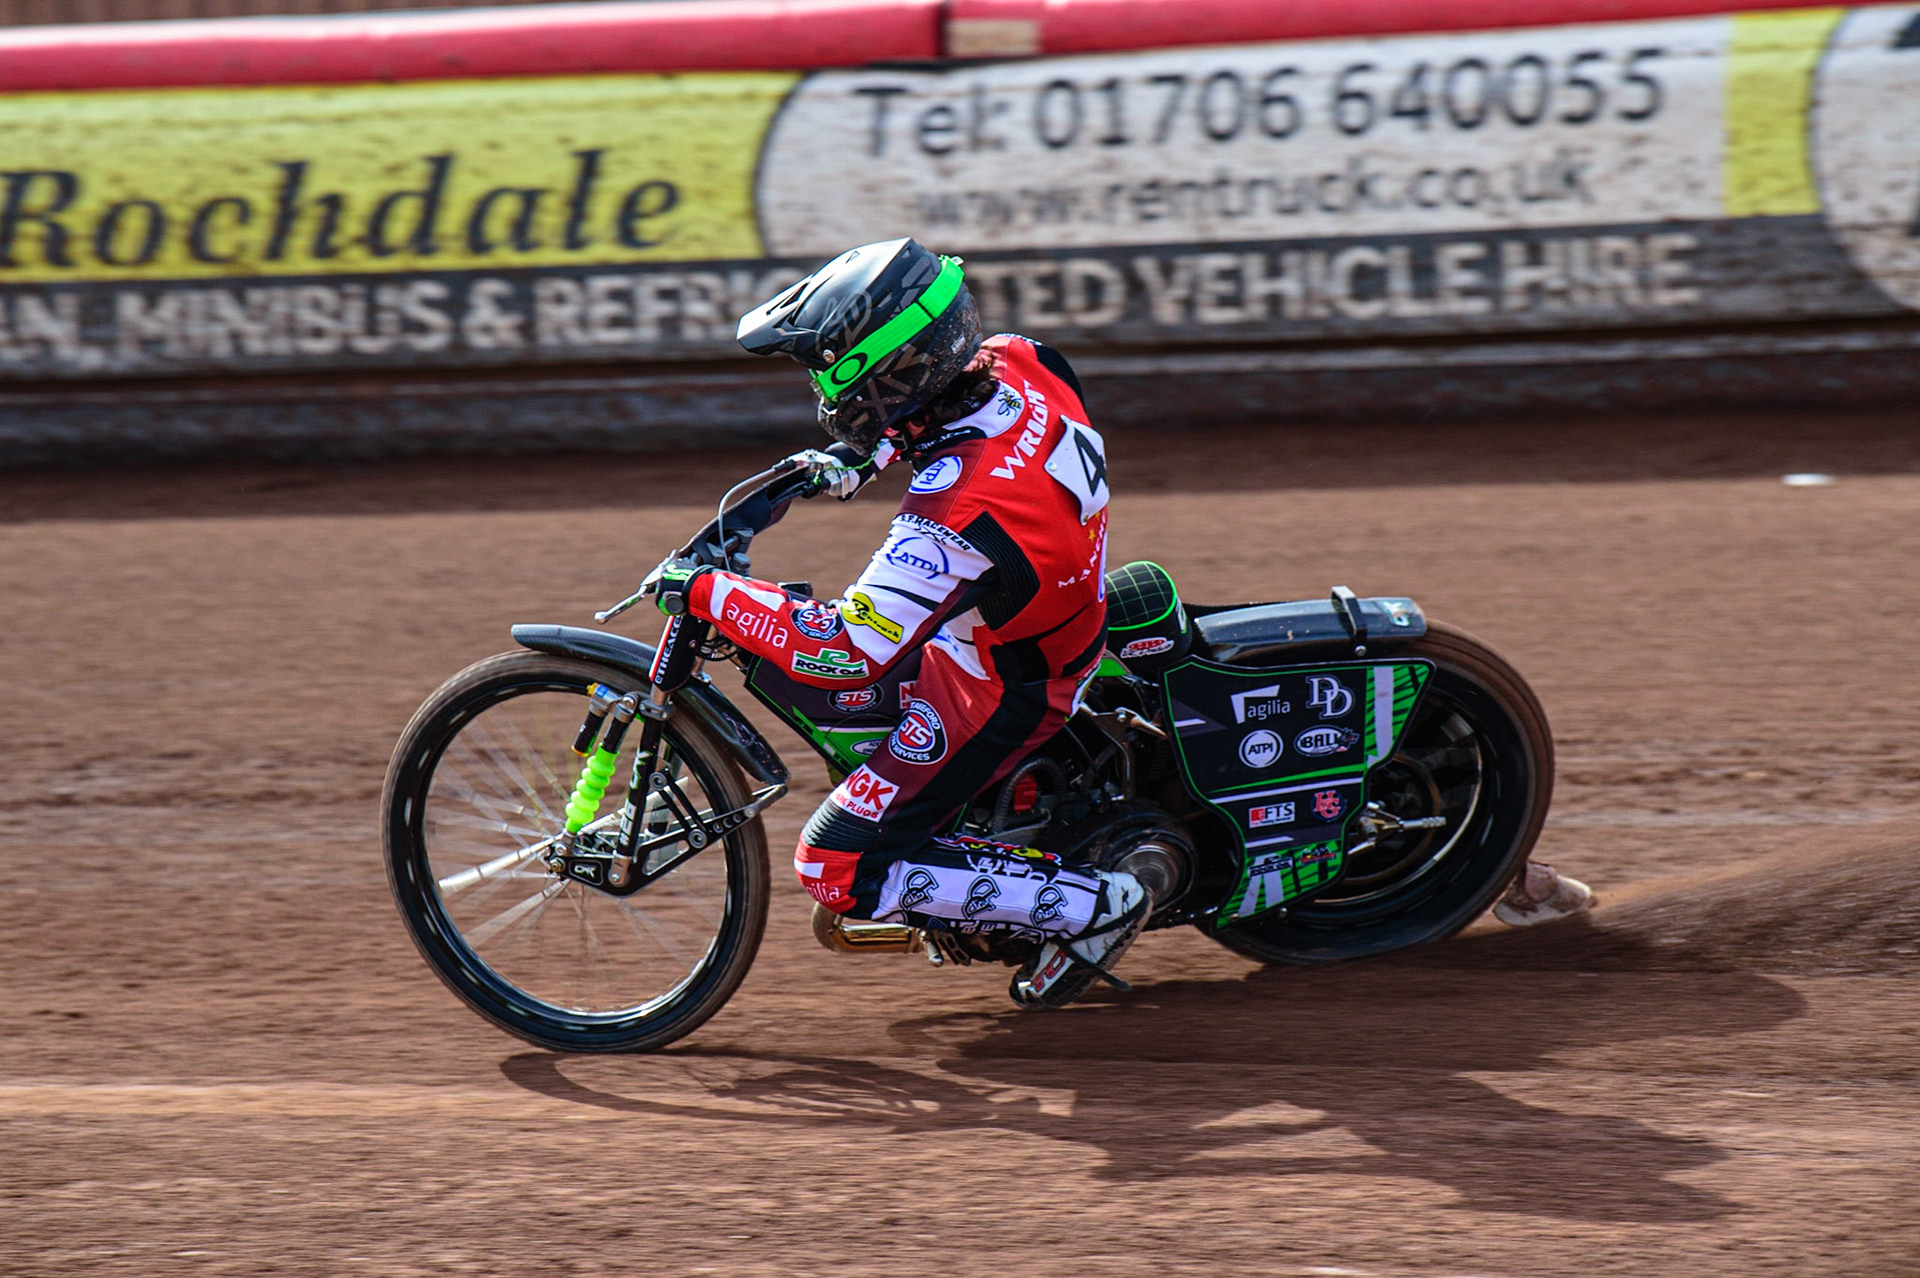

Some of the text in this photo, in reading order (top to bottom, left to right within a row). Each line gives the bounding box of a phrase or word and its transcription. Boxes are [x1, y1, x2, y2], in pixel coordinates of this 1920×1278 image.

[1032, 67, 1303, 150] 01706
[1332, 48, 1667, 134] 640055
[0, 148, 680, 268] Rochdale
[115, 280, 450, 358] MINIBUS
[462, 277, 529, 348] &
[1134, 241, 1493, 327] VEHICLE
[1504, 232, 1699, 309] HIRE
[1074, 426, 1107, 497] 4
[726, 602, 789, 648] agilia
[795, 660, 837, 675] ROCK
[838, 690, 873, 703] STS
[1247, 699, 1291, 721] agilia
[1248, 742, 1274, 756] ATPI
[846, 768, 893, 811] NGK
[1265, 803, 1293, 819] FTS
